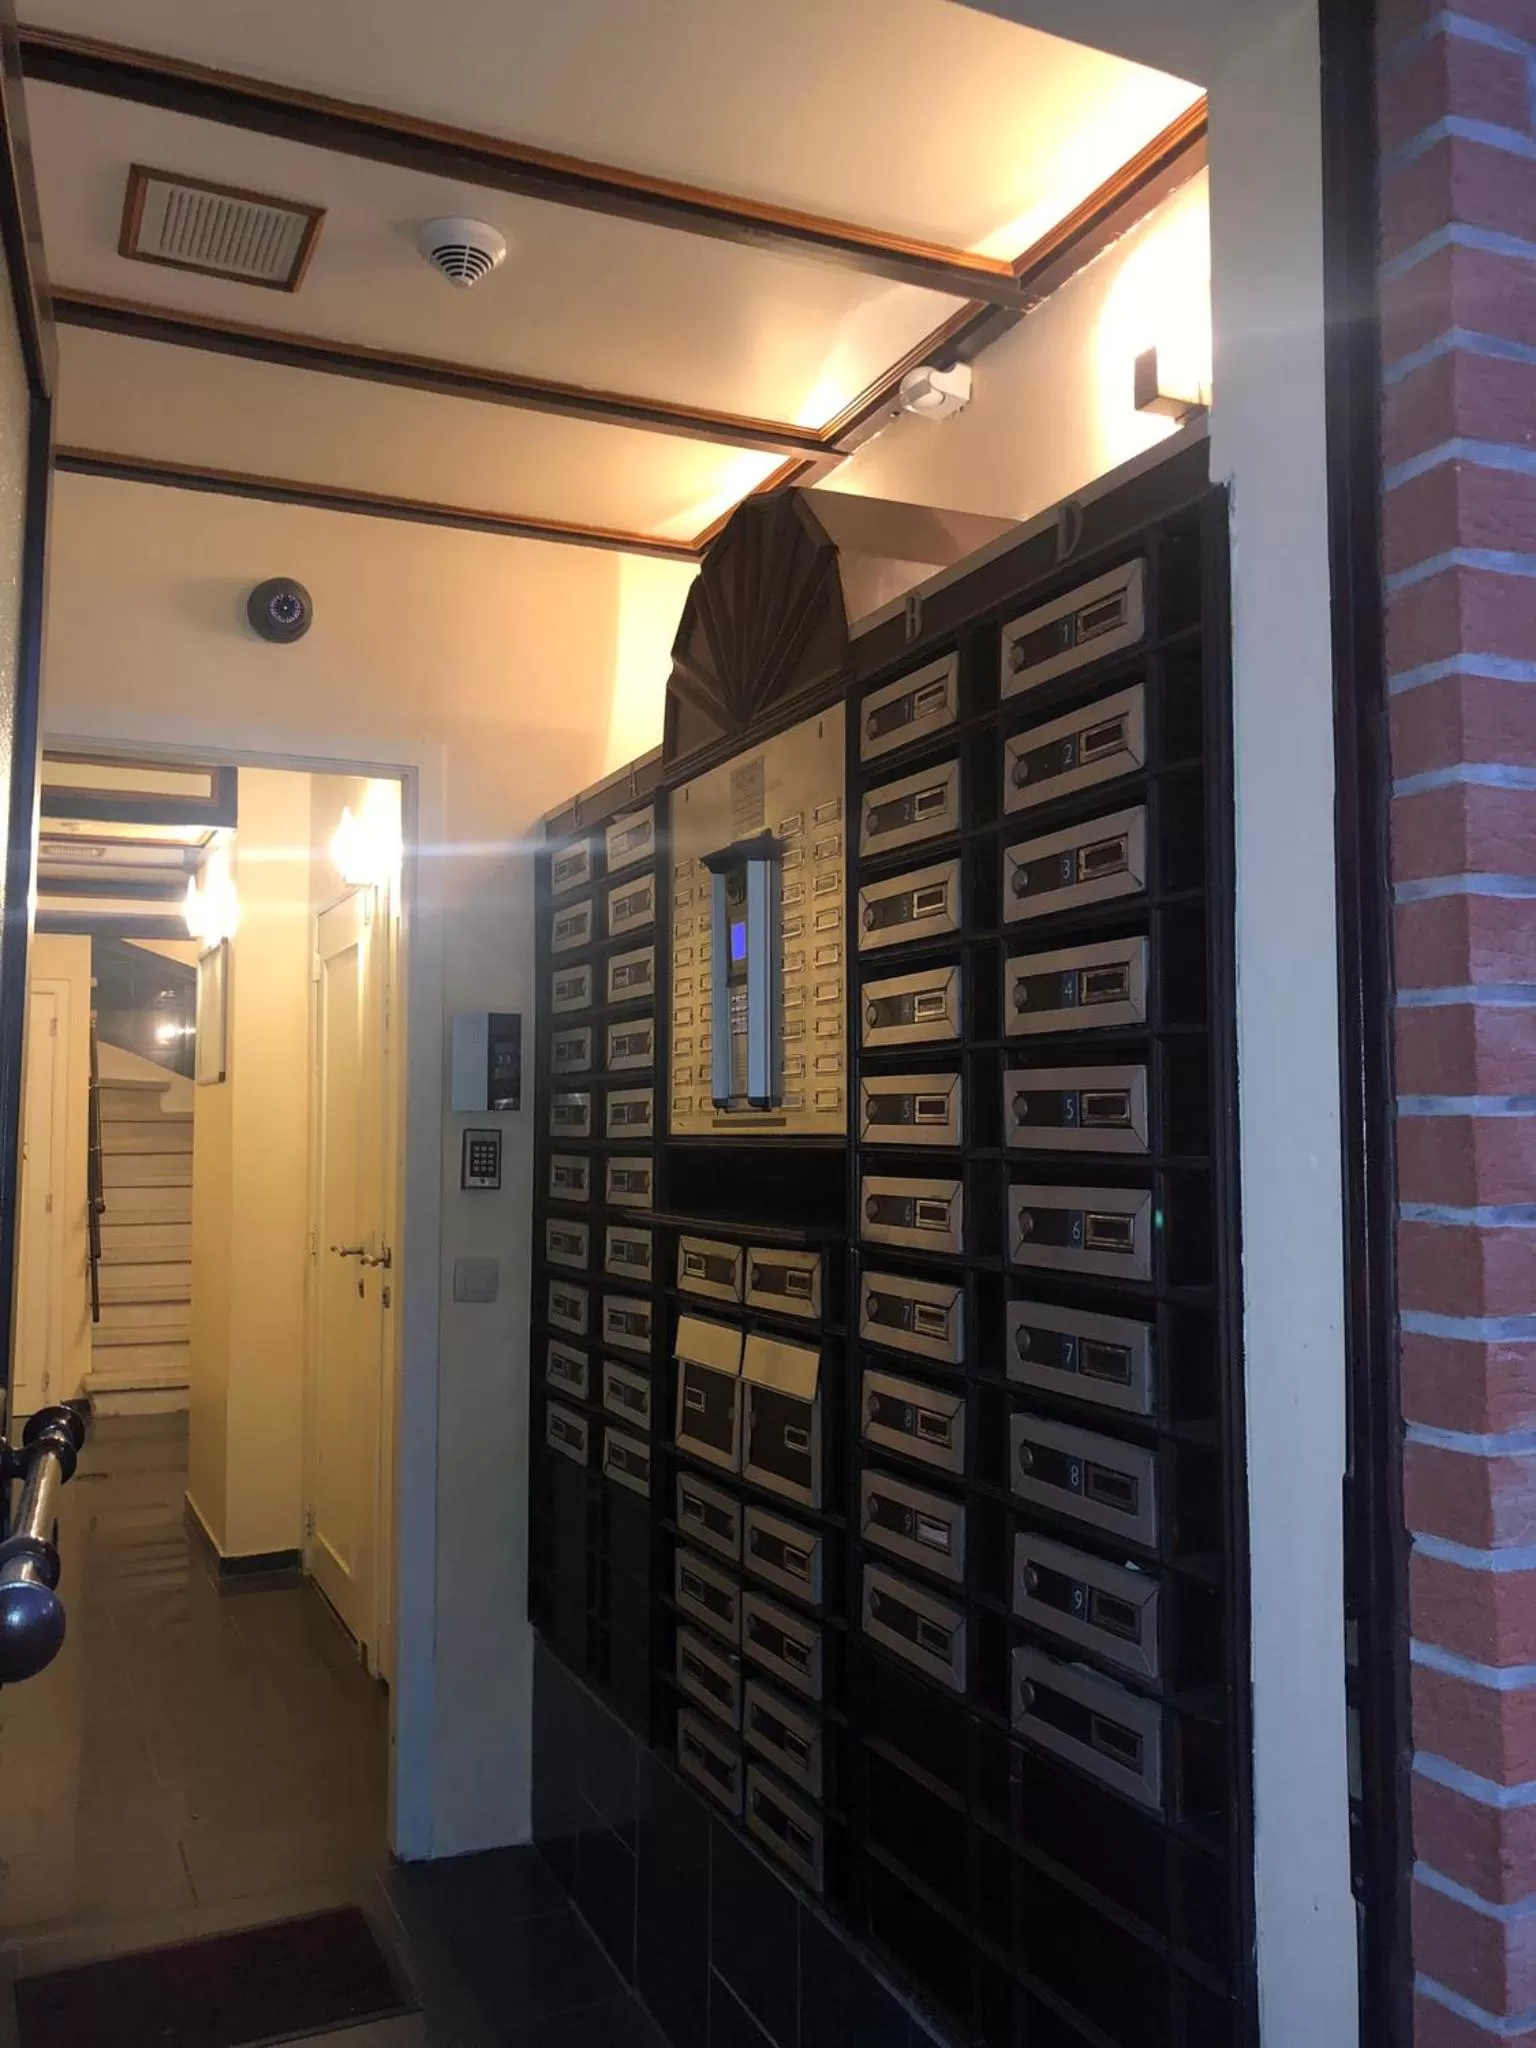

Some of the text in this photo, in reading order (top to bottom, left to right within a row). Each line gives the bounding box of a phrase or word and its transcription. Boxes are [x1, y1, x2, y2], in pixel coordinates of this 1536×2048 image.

[1062, 623, 1070, 645] 1
[1063, 743, 1073, 765] 2
[1062, 858, 1071, 880] 3
[1063, 980, 1074, 1001] 4
[1064, 1098, 1074, 1120] 5
[1072, 1219, 1081, 1240] 6
[902, 1305, 910, 1324] 7
[1063, 1342, 1073, 1365] 7
[1071, 1464, 1080, 1487] 8
[1074, 1589, 1083, 1610] 9
